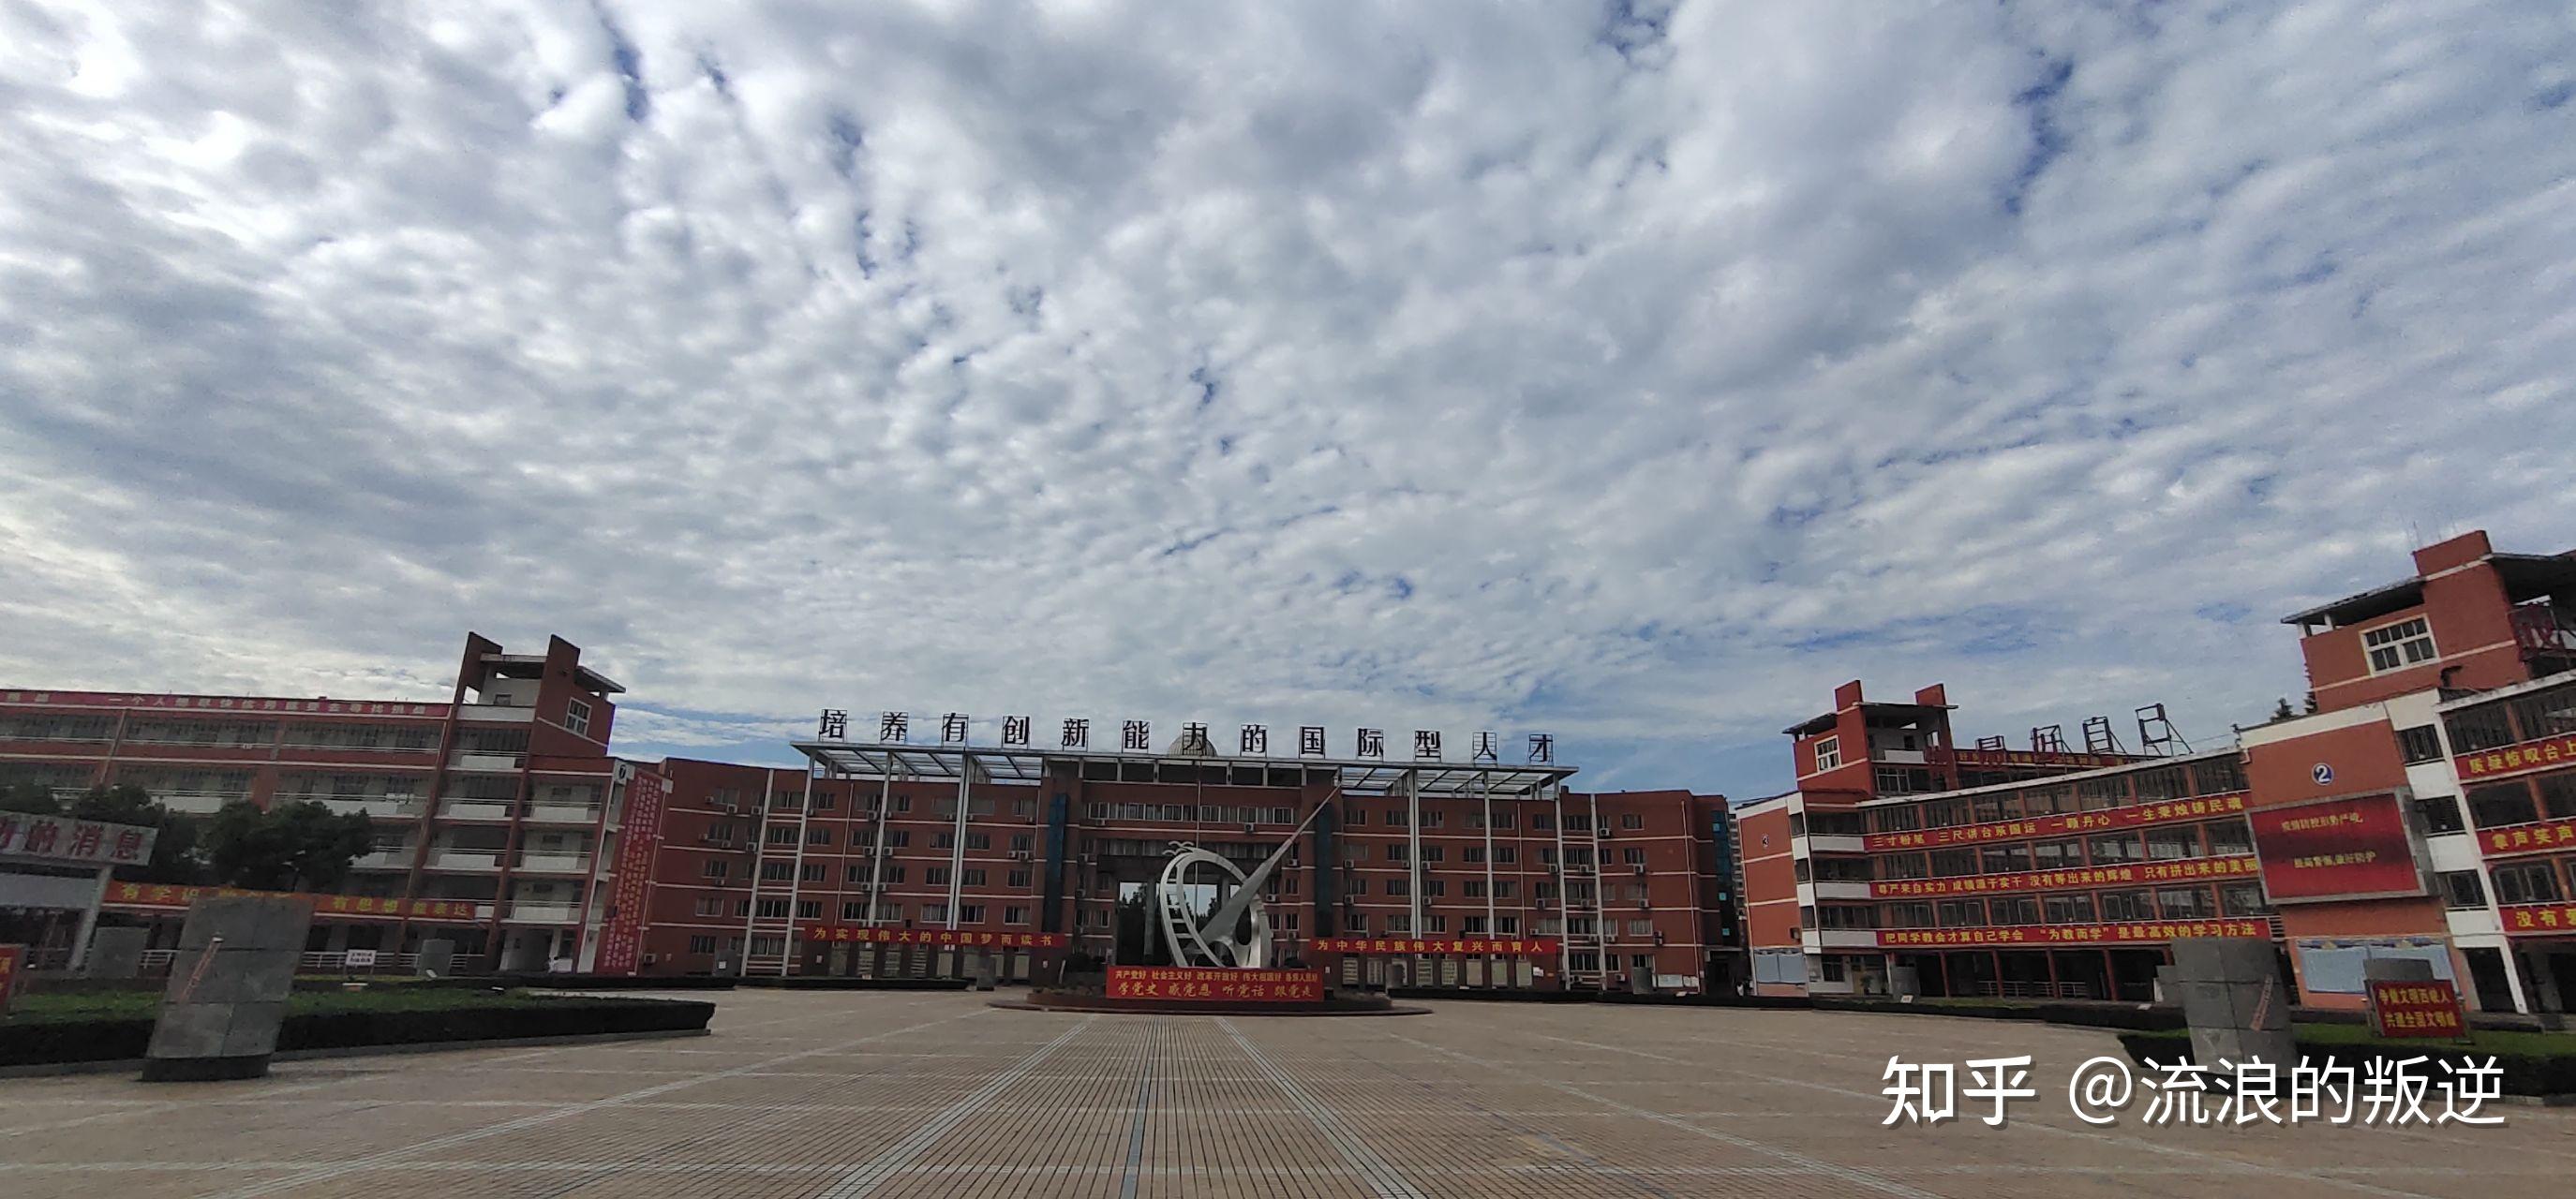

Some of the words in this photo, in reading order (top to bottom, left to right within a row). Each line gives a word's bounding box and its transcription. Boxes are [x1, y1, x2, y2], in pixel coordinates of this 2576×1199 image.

[819, 708, 1554, 764] 培养有创新能力的国际型人才
[2314, 763, 2332, 784] 2
[1872, 834, 1926, 848] 三寸粉笔
[1938, 822, 2036, 842] 三尺讲台系国运
[2050, 814, 2111, 829] 一颗丹心
[1878, 881, 1946, 896] 尊严来自实力
[1953, 876, 2022, 891] 成绩源于实干
[2029, 867, 2134, 887] 没有等出来的辉煌
[813, 927, 1053, 946] 为实现伟大的中国梦而读书
[1884, 928, 2024, 943] 把同学教会才算自己学会
[2117, 922, 2257, 940] 是最高效的学习方法
[1317, 939, 1543, 953] 为中华民族伟大复兴而育人
[1114, 970, 1147, 980] 共产党好
[1152, 971, 1193, 981] 社会主义好
[1197, 971, 1238, 982] 改革开放好
[1118, 983, 1159, 997] 学党史
[1222, 984, 1265, 998] 听党话
[1273, 984, 1314, 999] 跟党走
